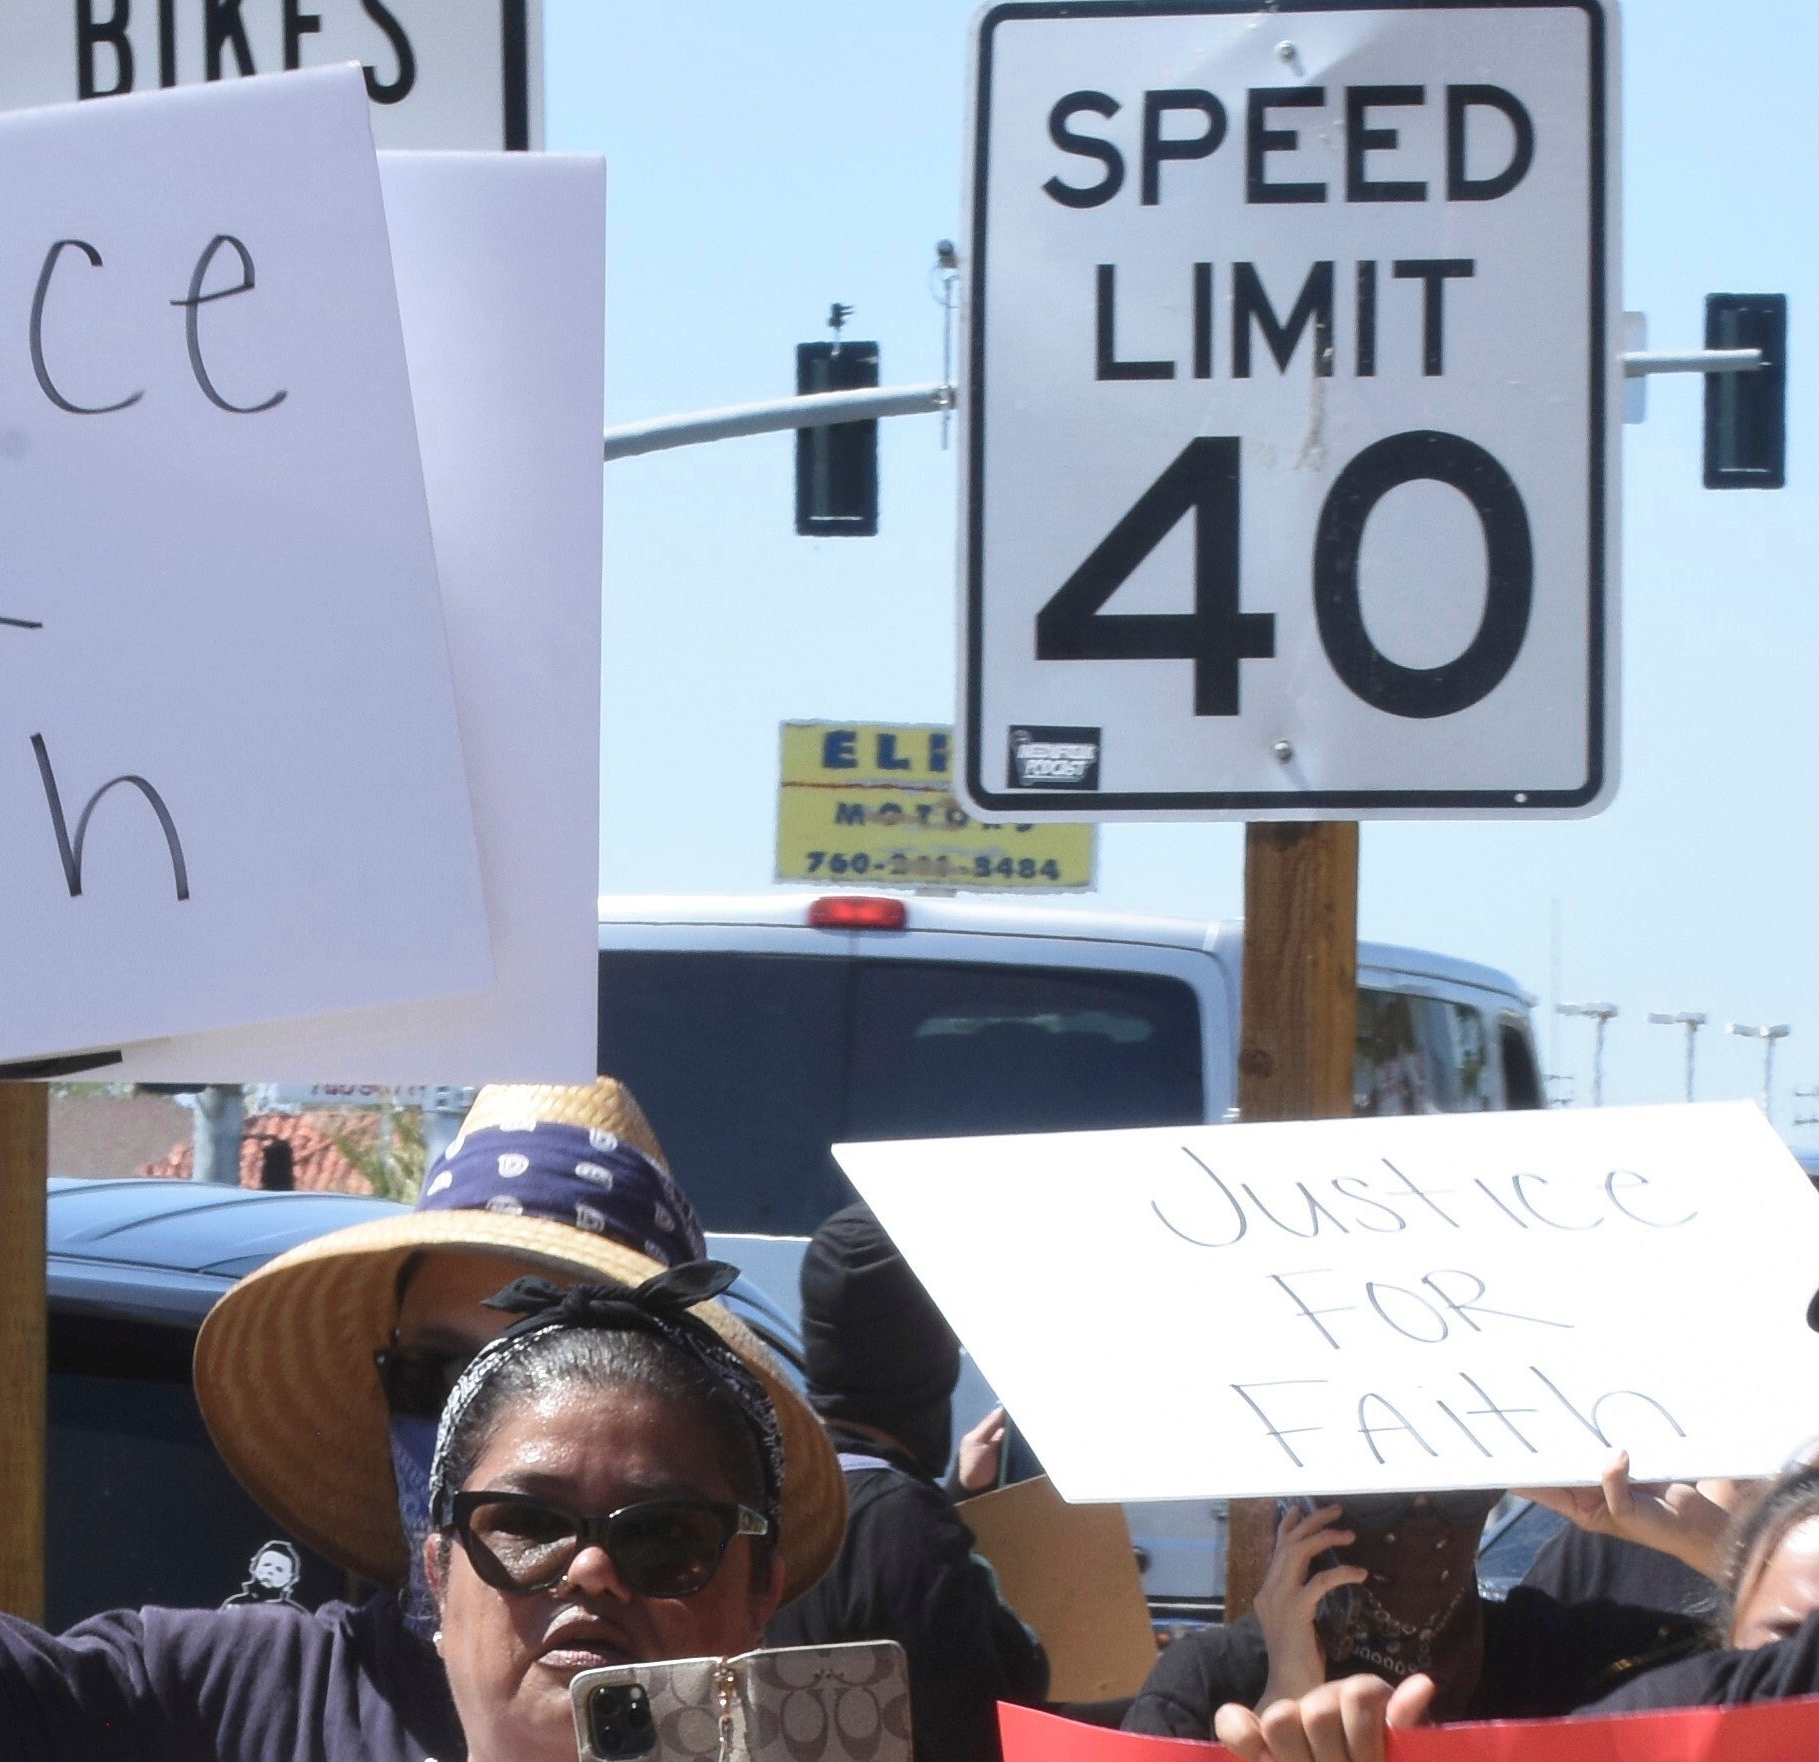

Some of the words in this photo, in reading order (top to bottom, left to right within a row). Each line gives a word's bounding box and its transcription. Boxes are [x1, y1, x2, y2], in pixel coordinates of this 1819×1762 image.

[1041, 83, 1535, 209] SPEED
[1094, 258, 1474, 381] LIMIT
[1036, 429, 1534, 718] 40
[822, 730, 949, 773] ELI
[834, 802, 1034, 832] MOTO
[1269, 1268, 1575, 1350] FOR
